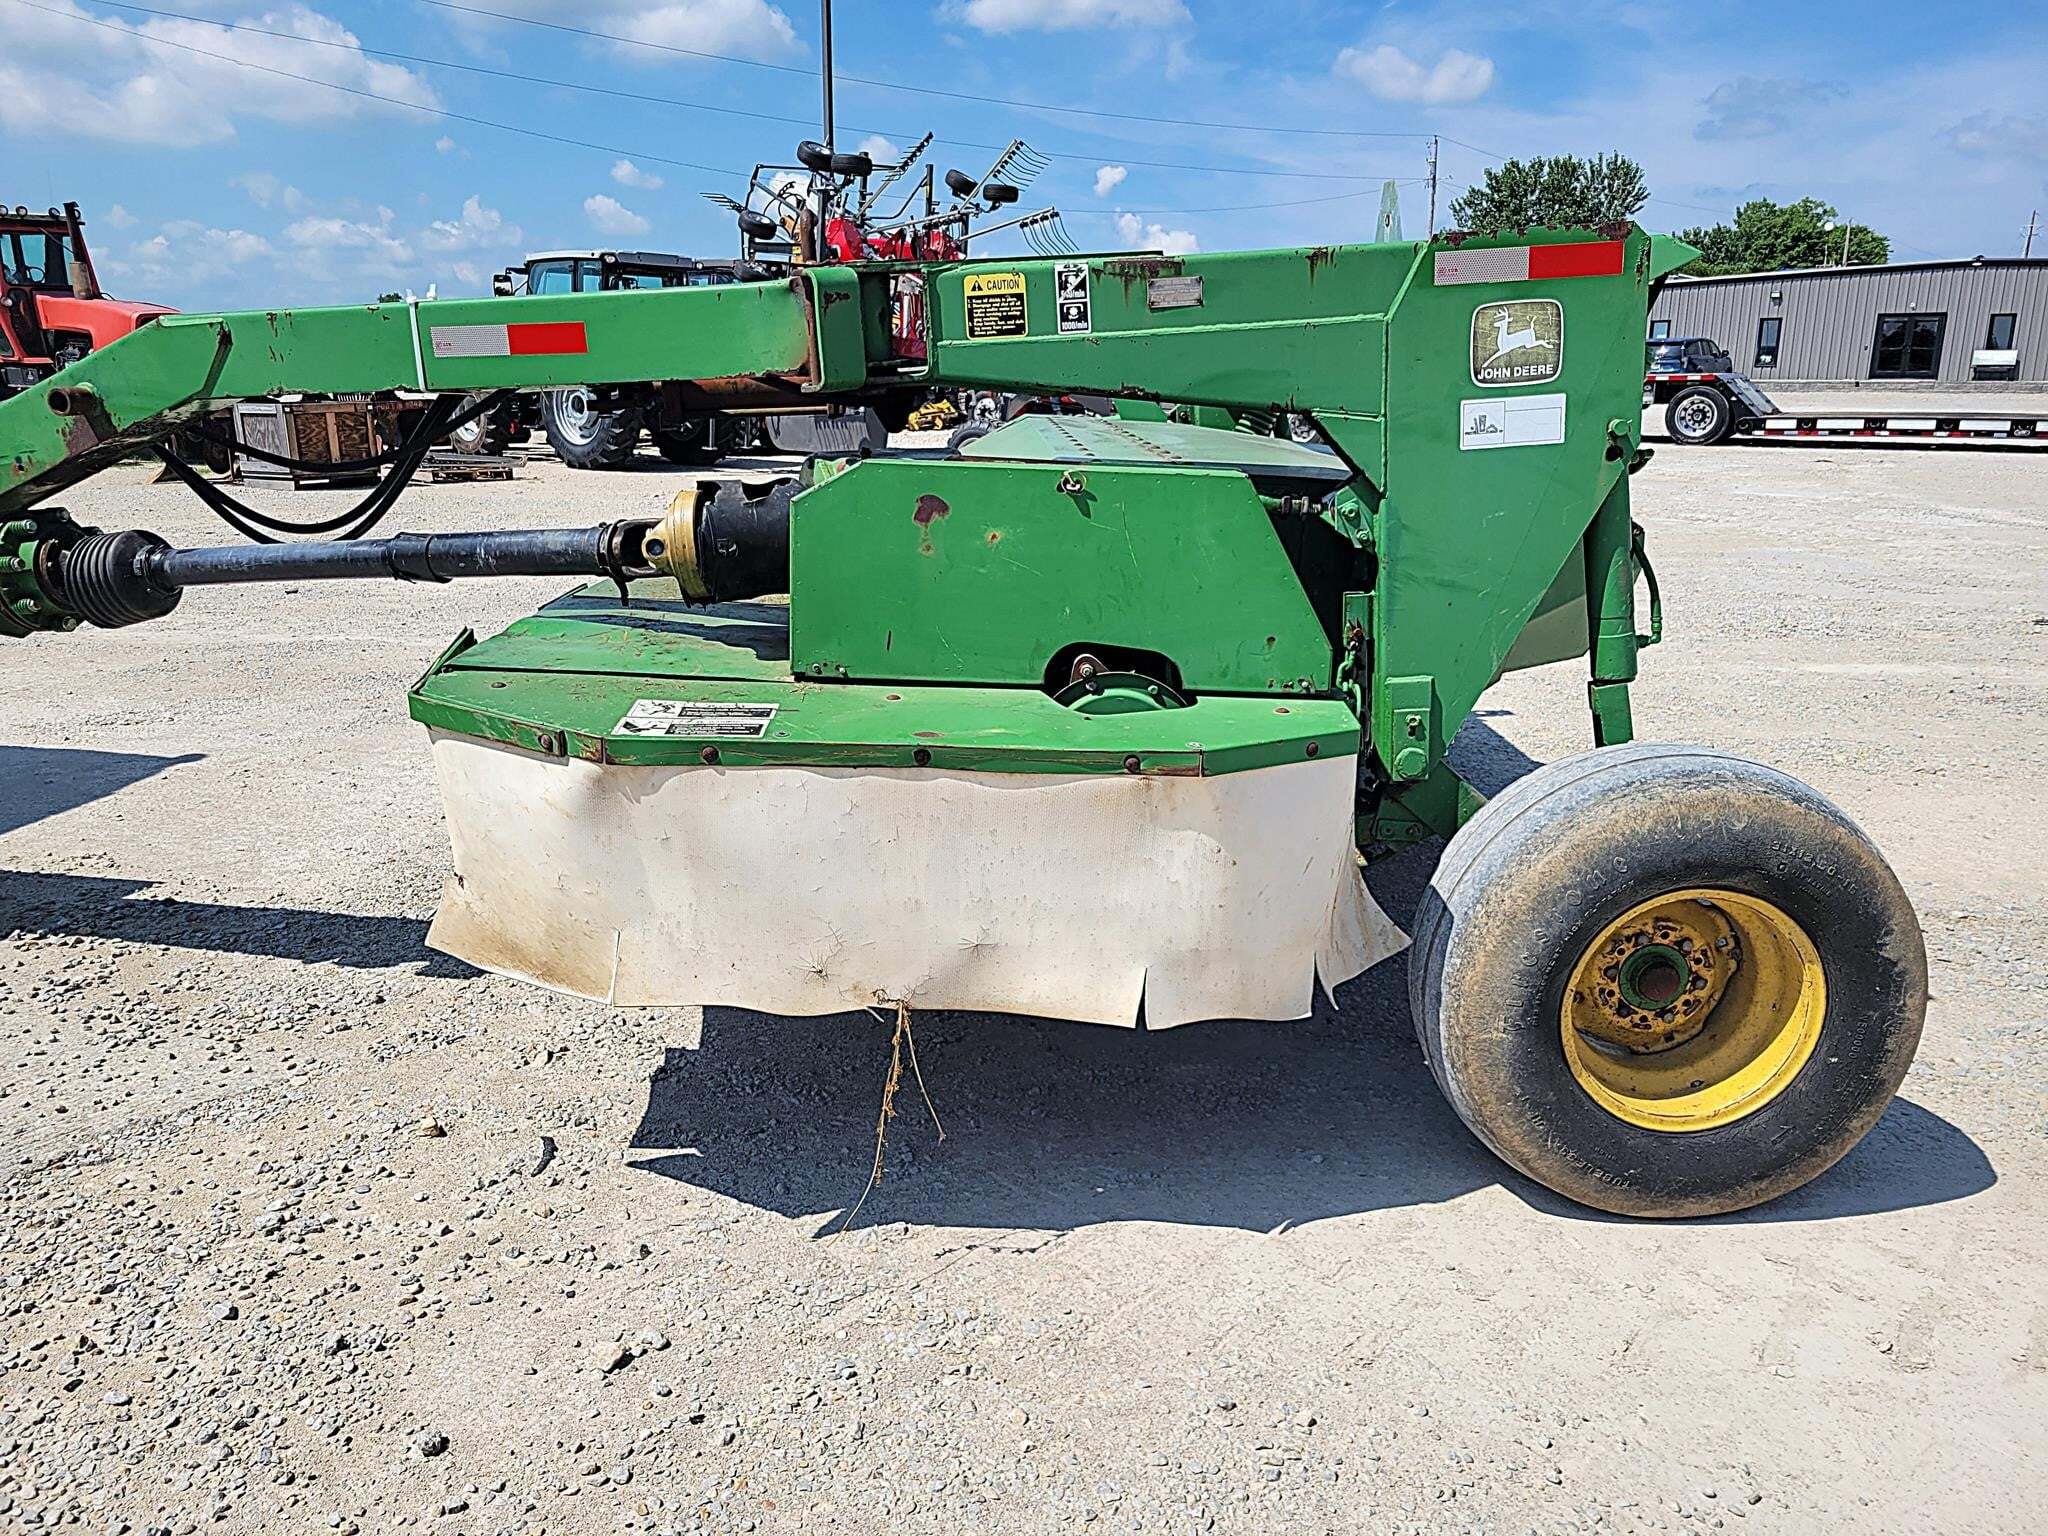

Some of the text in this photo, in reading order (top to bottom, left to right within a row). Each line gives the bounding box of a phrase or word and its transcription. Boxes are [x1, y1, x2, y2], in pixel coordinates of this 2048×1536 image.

[987, 279, 1020, 290] CAUTION
[1061, 320, 1088, 330] 1000/min
[1477, 364, 1554, 380] JOHN DEERE
